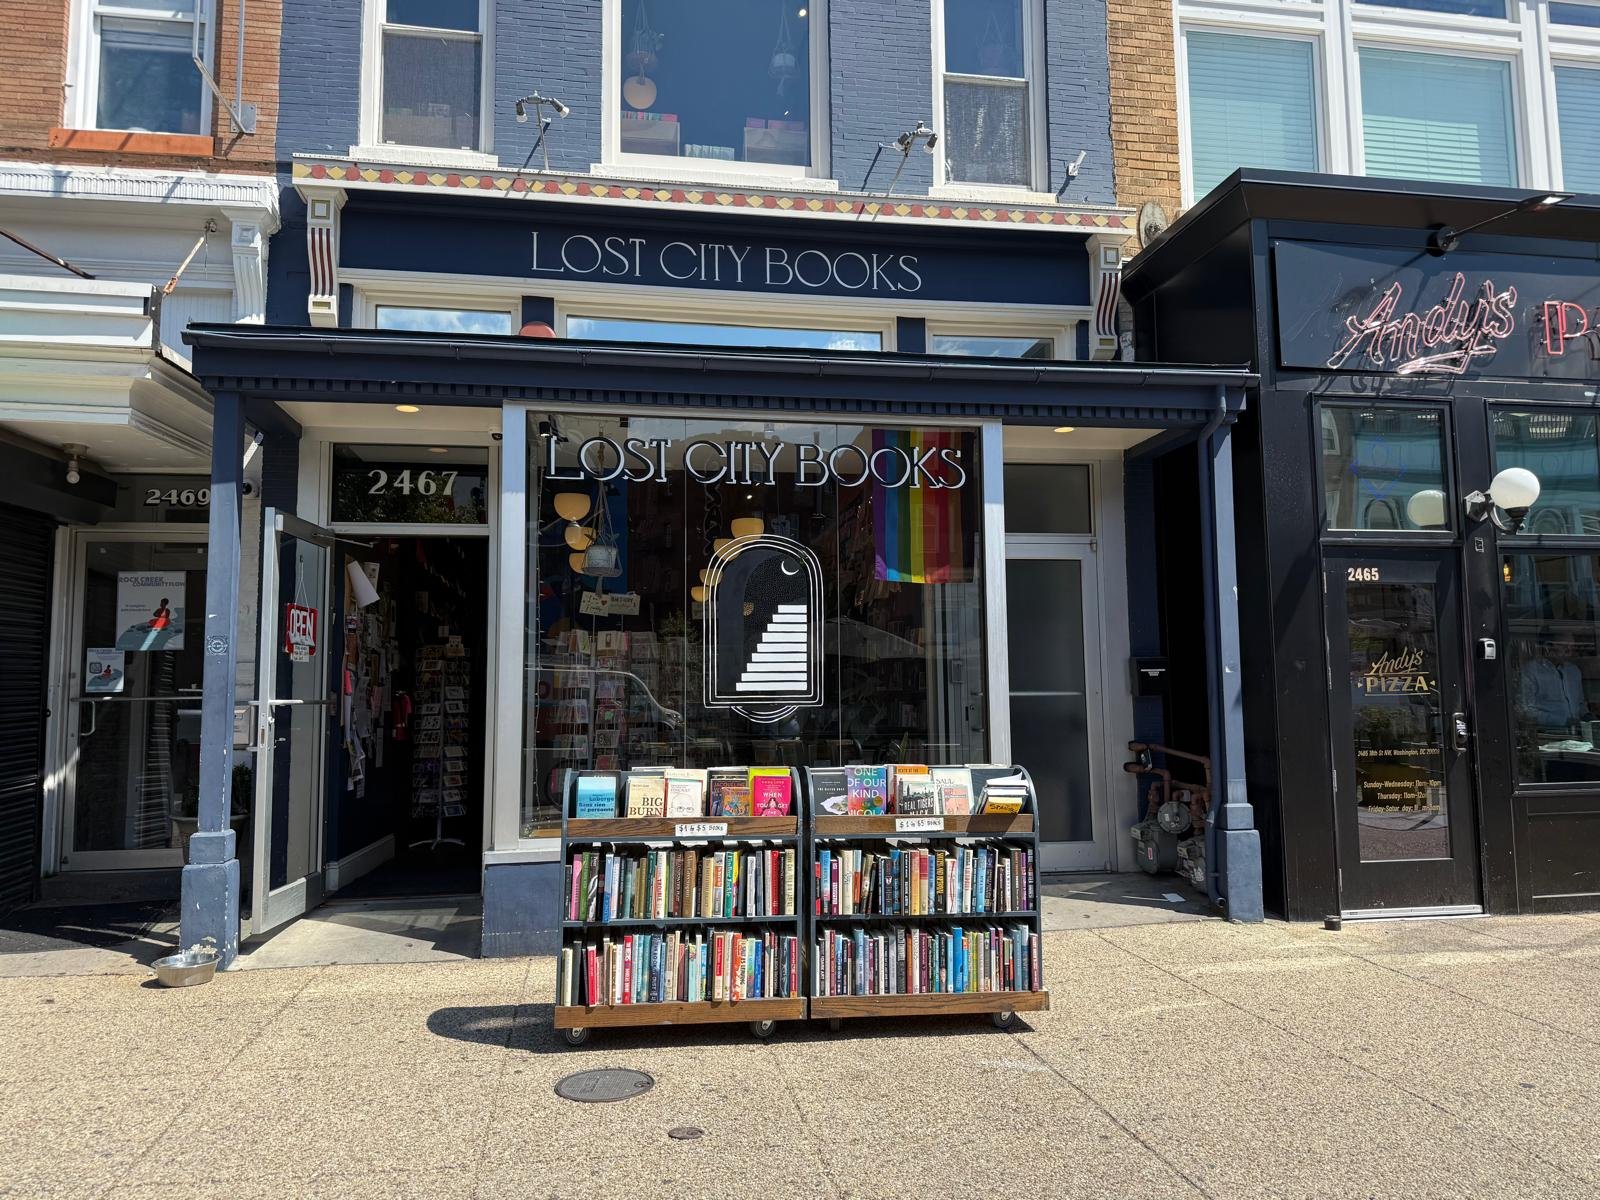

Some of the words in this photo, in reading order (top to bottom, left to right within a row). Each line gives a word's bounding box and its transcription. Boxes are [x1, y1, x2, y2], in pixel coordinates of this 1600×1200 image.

[531, 231, 646, 277] LOST
[660, 241, 751, 284] CITY
[765, 246, 922, 293] BOOKS
[1327, 271, 1517, 375] Andy's
[544, 434, 672, 484] LOST
[684, 438, 785, 486] CITY
[795, 443, 967, 490] BOOKS
[367, 469, 459, 496] 2467
[145, 488, 211, 507] 2469
[1347, 567, 1380, 582] 2465
[290, 608, 314, 640] OPEN
[1370, 646, 1424, 675] Andy's
[1365, 675, 1429, 693] PIZZA
[854, 768, 878, 776] ONE
[848, 778, 860, 787] OF
[863, 778, 886, 787] OUR
[1363, 780, 1414, 790] Sunday-Wednesday:
[642, 797, 663, 806] BIG
[852, 789, 879, 798] KIND
[1377, 792, 1402, 801] Thursday:
[629, 807, 663, 816] BURN
